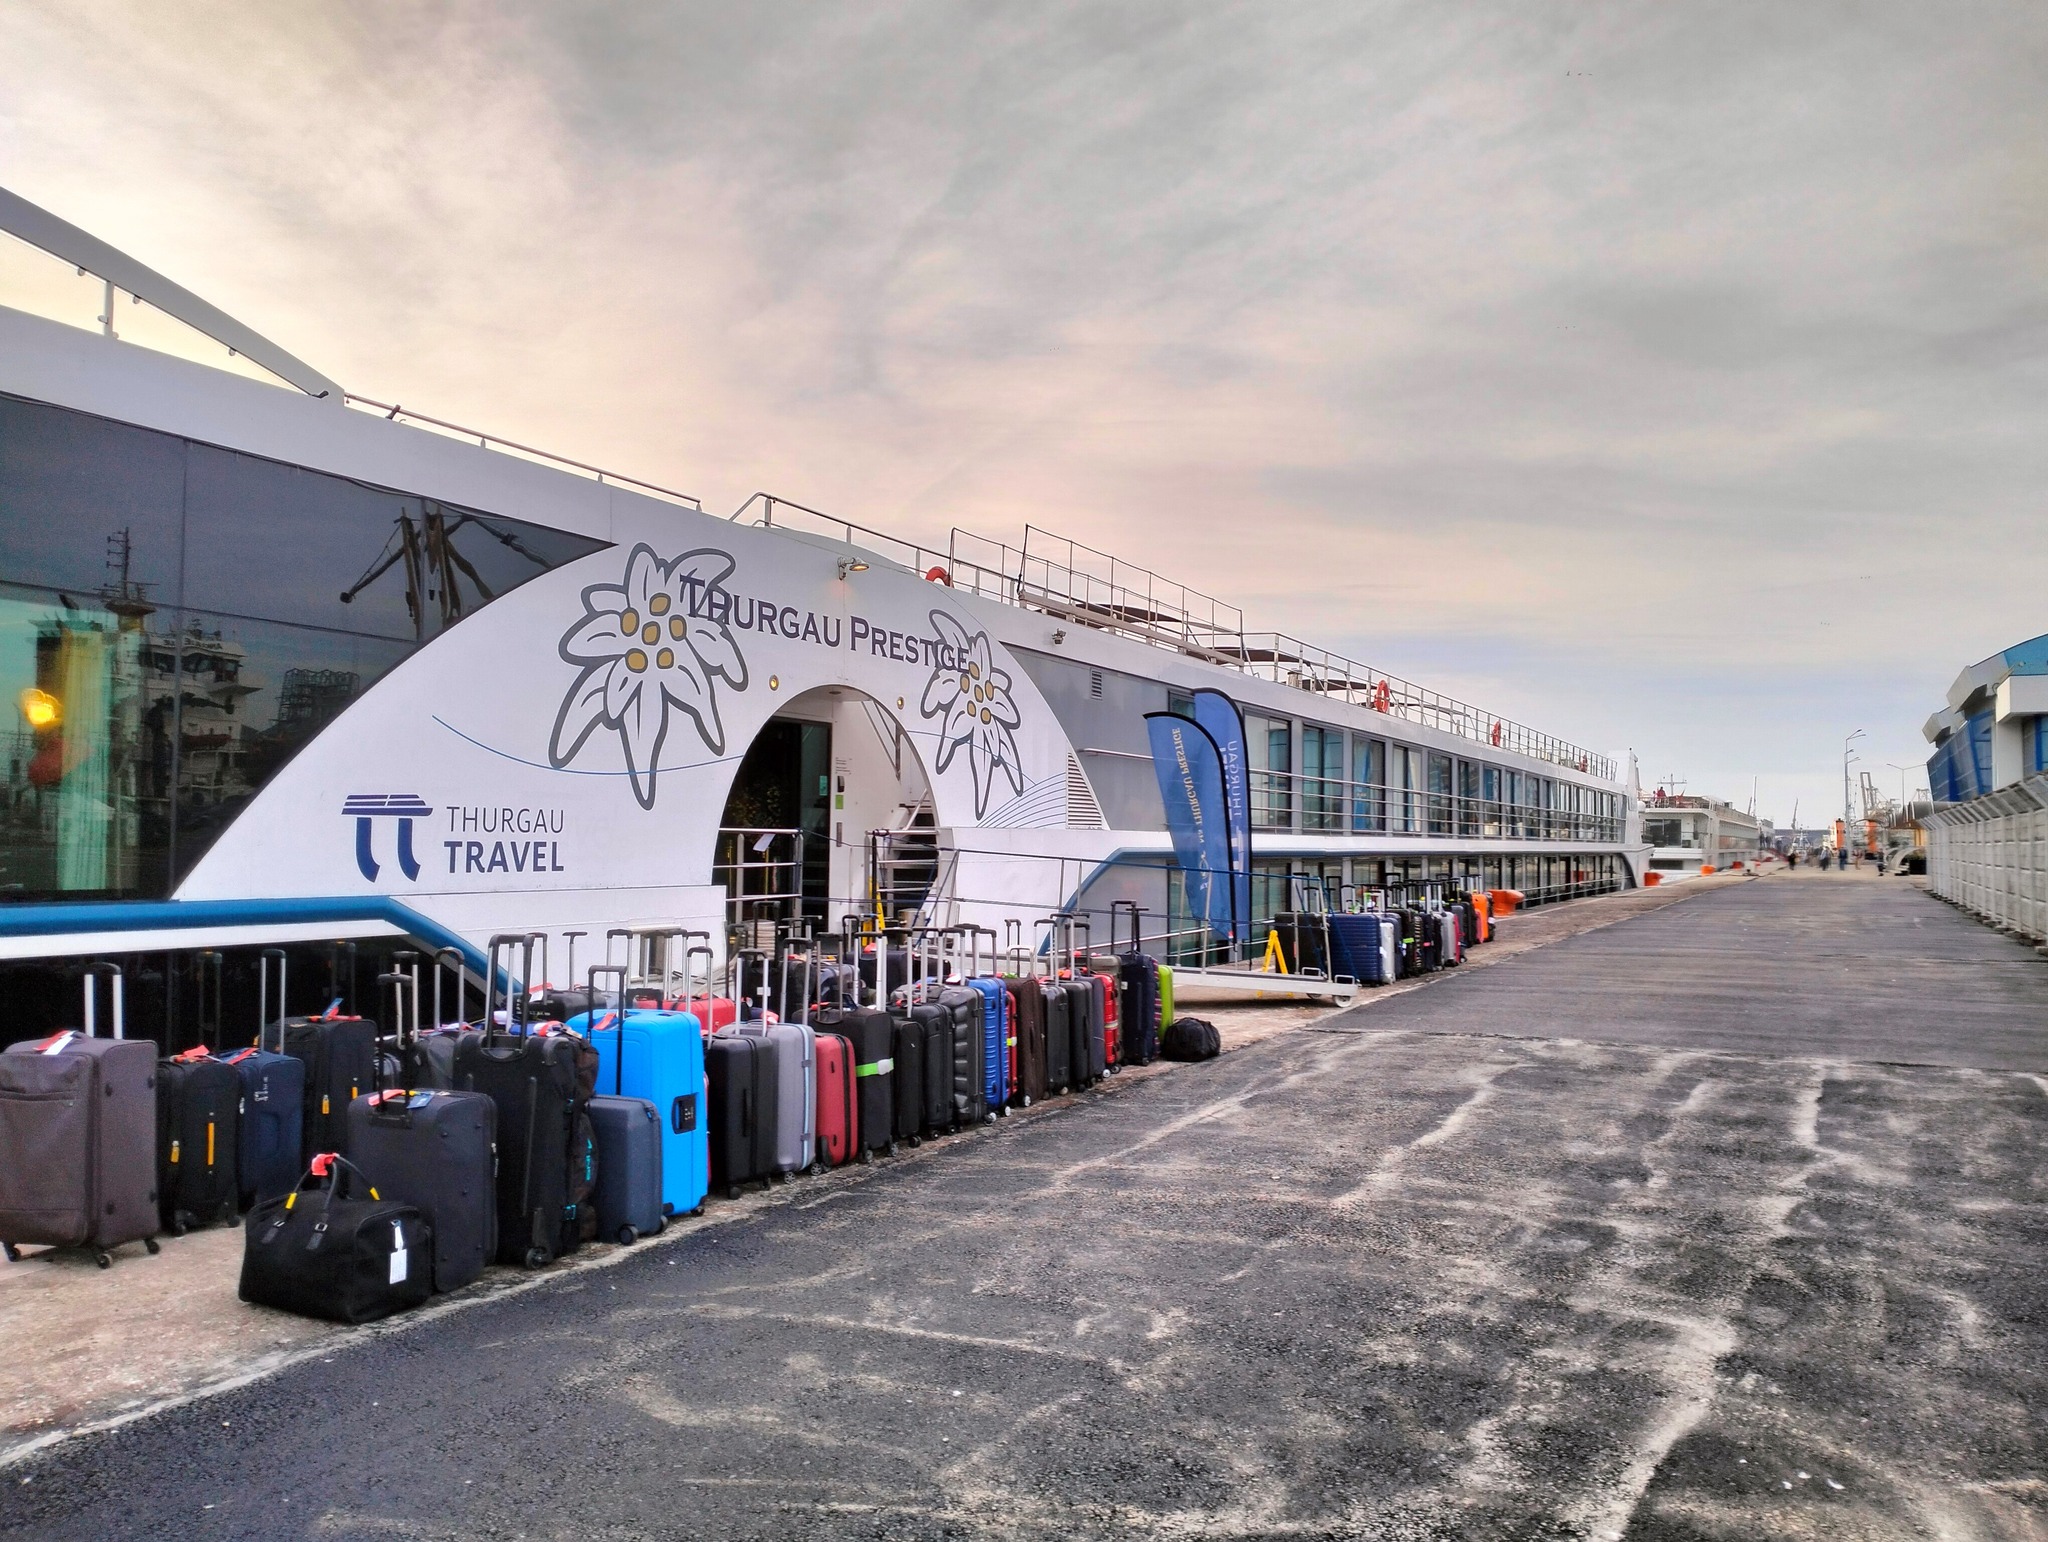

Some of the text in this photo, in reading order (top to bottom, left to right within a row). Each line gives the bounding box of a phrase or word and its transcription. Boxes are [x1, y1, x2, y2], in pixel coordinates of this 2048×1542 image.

[680, 573, 970, 674] THURGAU PRESTIGE
[446, 806, 564, 833] THURGAU
[444, 841, 564, 873] TRAVEL
